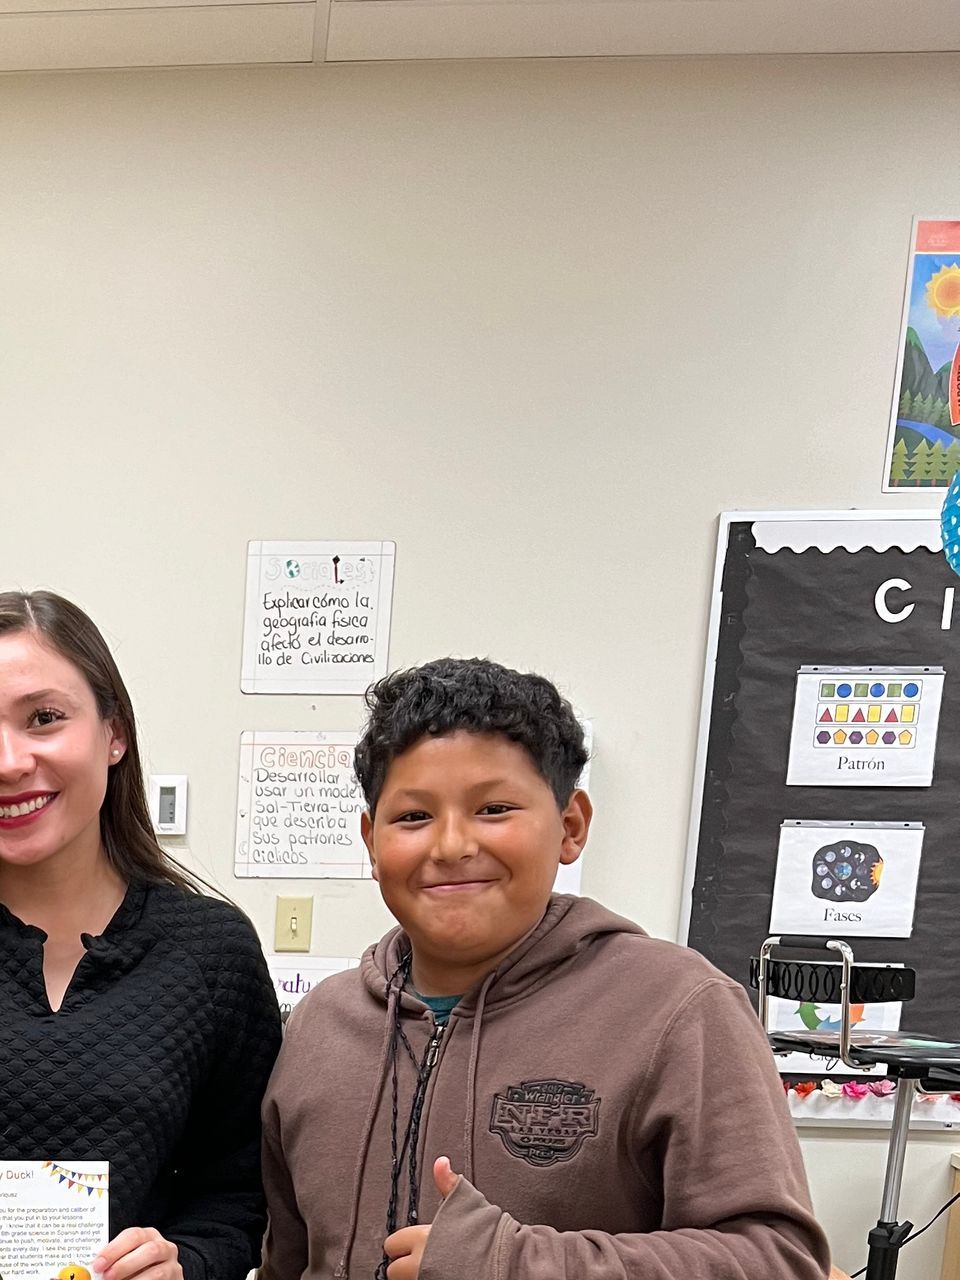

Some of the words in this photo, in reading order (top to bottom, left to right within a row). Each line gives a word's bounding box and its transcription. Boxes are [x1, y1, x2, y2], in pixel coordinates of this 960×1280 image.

[313, 592, 349, 609] cómo
[308, 632, 321, 646] el
[276, 651, 292, 666] de
[260, 746, 352, 769] Ciencia
[837, 755, 885, 771] Patrón
[254, 768, 340, 784] Desarrollar
[256, 786, 287, 797] usar
[295, 786, 314, 798] un
[319, 784, 362, 798] model
[254, 815, 278, 831] que
[284, 813, 346, 829] describa
[289, 829, 353, 852] patrones
[823, 908, 862, 922] Fases
[524, 1090, 579, 1107] Wrangler
[7, 1170, 34, 1180] Duck!
